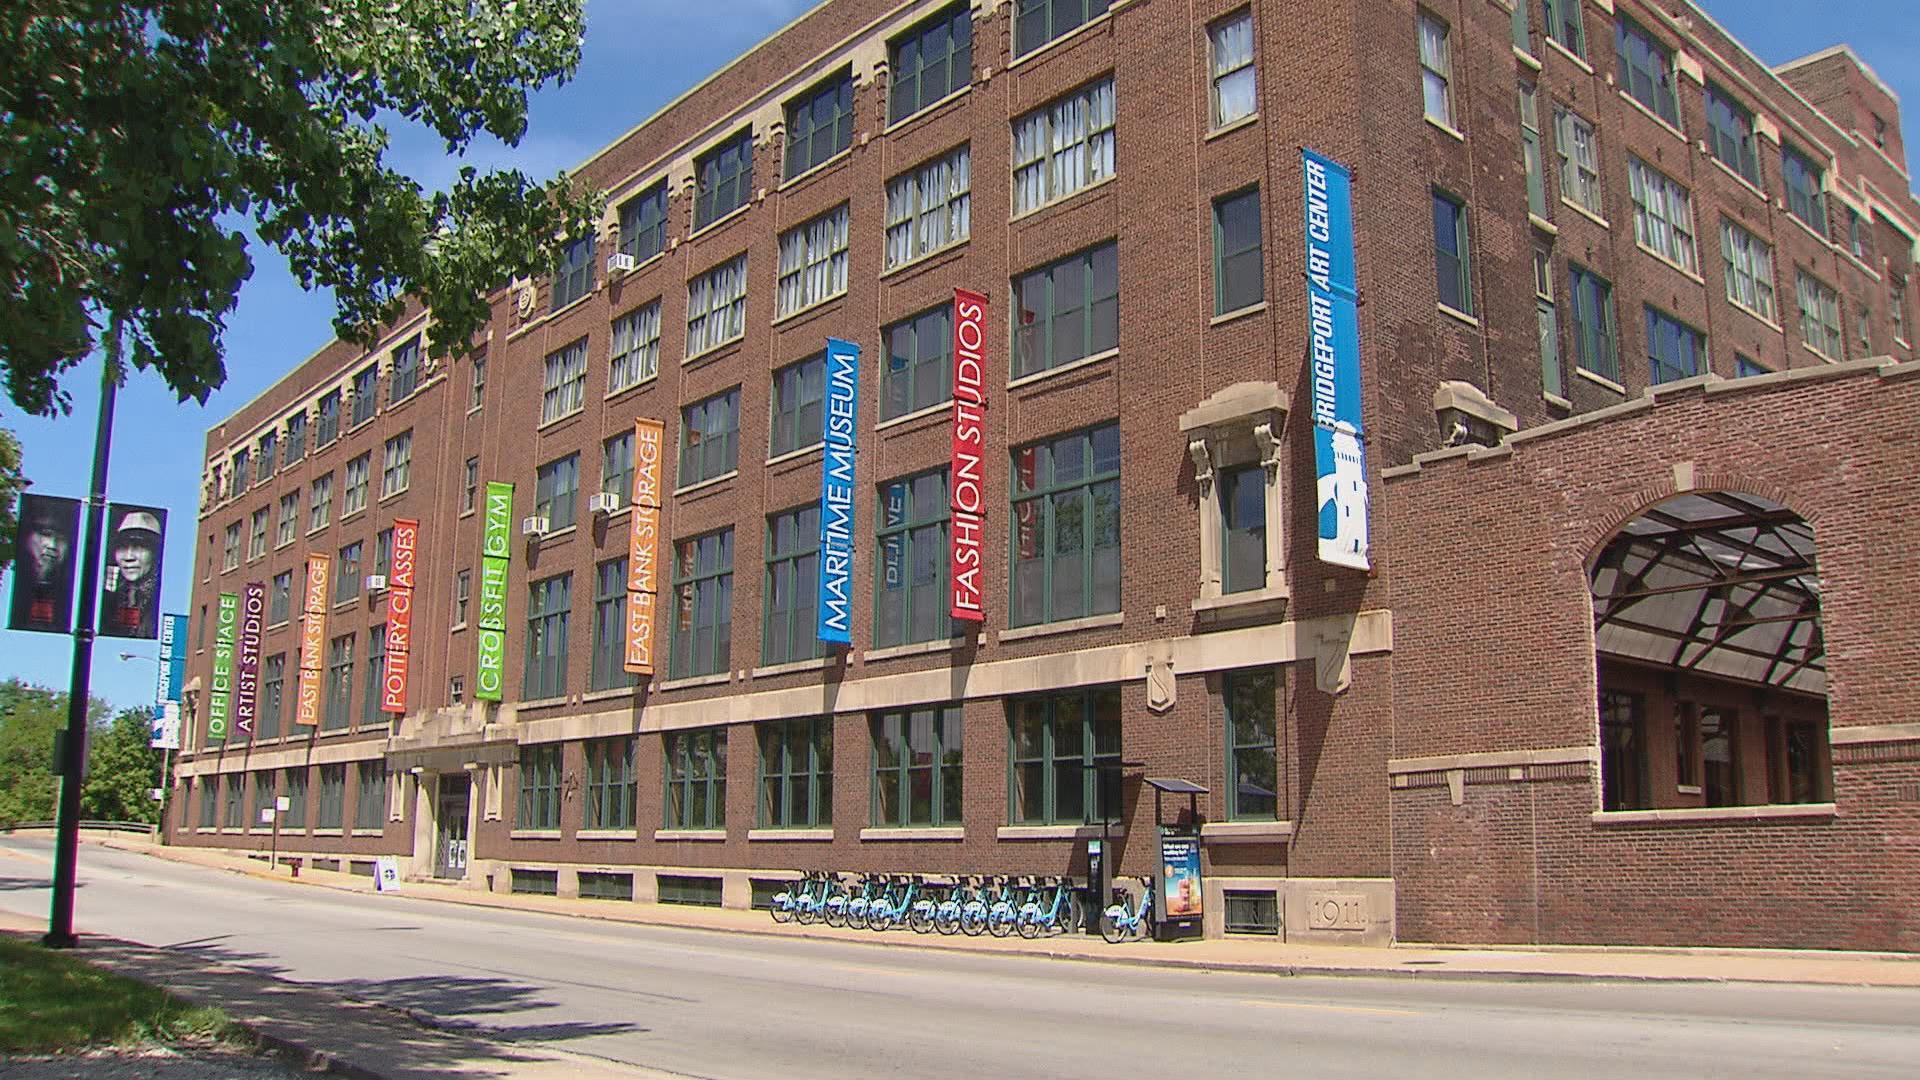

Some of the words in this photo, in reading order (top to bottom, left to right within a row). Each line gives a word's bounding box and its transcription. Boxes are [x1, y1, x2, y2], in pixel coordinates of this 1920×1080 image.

[1305, 159, 1330, 243] CENTER
[1309, 243, 1331, 292] ART
[957, 301, 983, 445] STUDIOS
[1311, 291, 1335, 431] BRIDGEPORT
[828, 353, 855, 482] MUSEUM
[636, 430, 658, 537] STORAGE
[487, 495, 509, 556] GYM
[825, 487, 851, 631] MARITIME
[956, 453, 980, 610] FASHION
[307, 560, 327, 634] STORAGE
[392, 527, 415, 613] CLASSES
[633, 544, 653, 603] BANK
[216, 598, 235, 658] SPACE
[243, 587, 263, 665] STUDIOS
[304, 636, 321, 679] BANK
[386, 619, 409, 707] POTTERY
[480, 567, 504, 692] CROSSFIT
[630, 611, 650, 664] EAST
[209, 666, 229, 733] OFFICE
[238, 671, 256, 732] ARTIST
[301, 683, 318, 719] EAST
